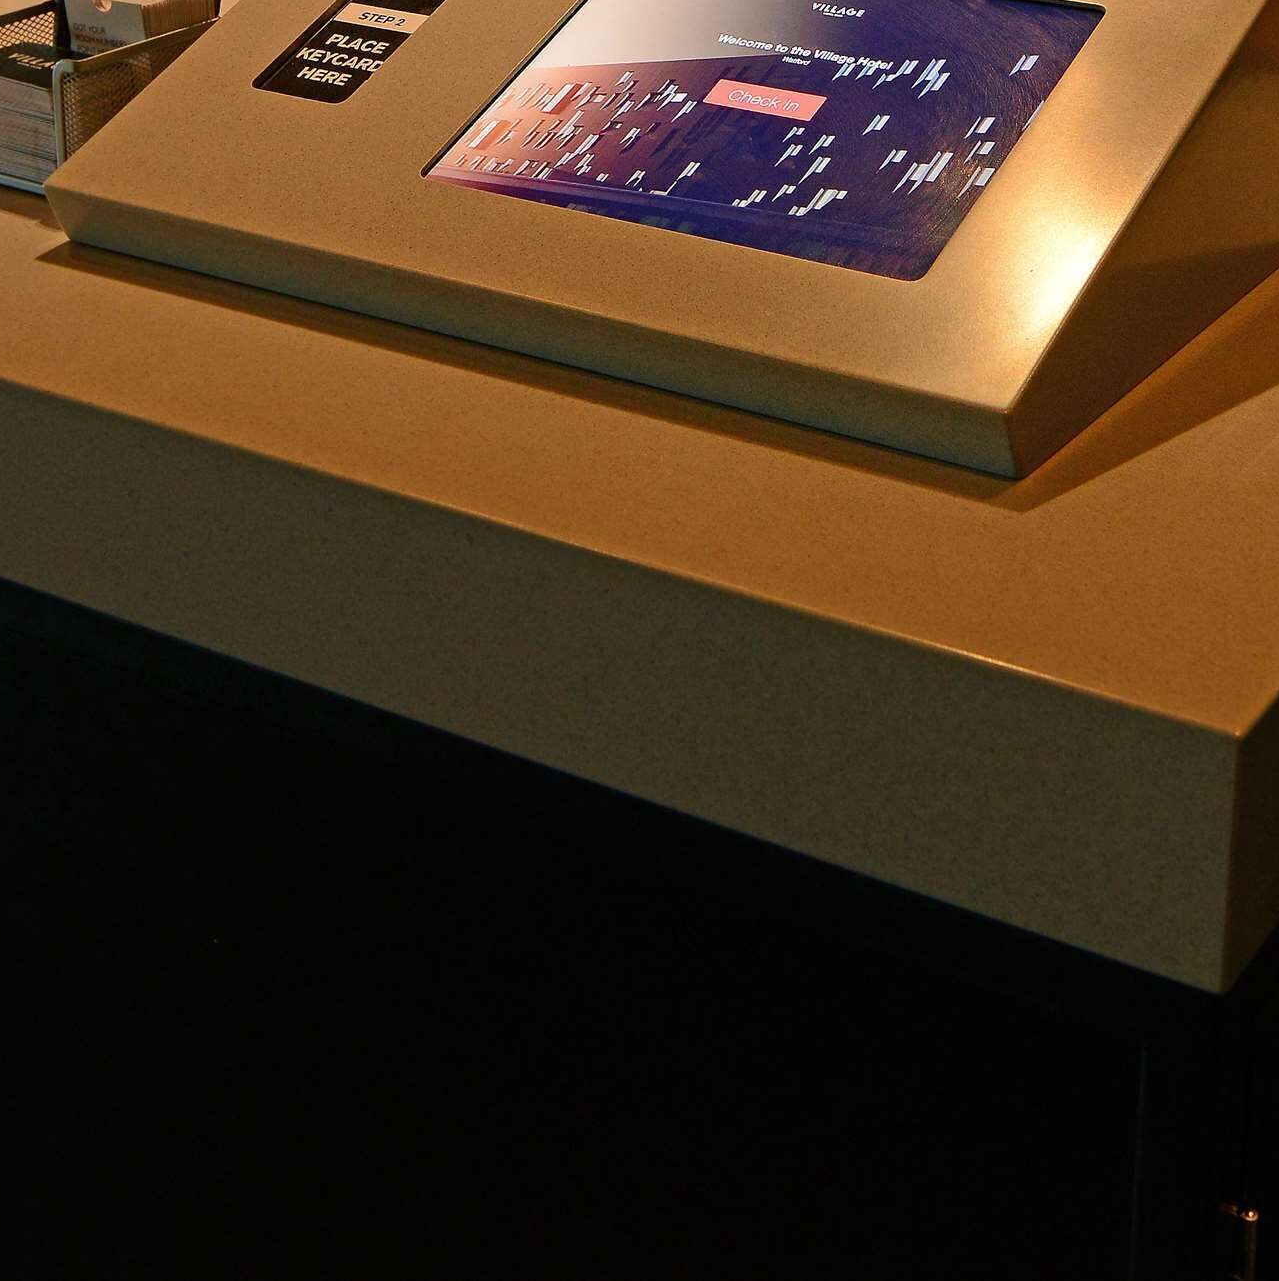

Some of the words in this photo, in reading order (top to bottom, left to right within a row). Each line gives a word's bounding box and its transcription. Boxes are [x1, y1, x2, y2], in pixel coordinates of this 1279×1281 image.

[358, 11, 395, 25] STEP
[395, 18, 406, 26] 2
[811, 2, 866, 18] VILLAGE
[325, 33, 390, 55] PLACE
[718, 33, 774, 52] Welcome
[775, 43, 789, 54] to
[790, 46, 812, 58] the
[813, 49, 856, 65] Village
[856, 56, 895, 71] Hotel
[296, 47, 384, 72] KEYCARD
[296, 66, 353, 86] HERE
[728, 88, 781, 109] Check
